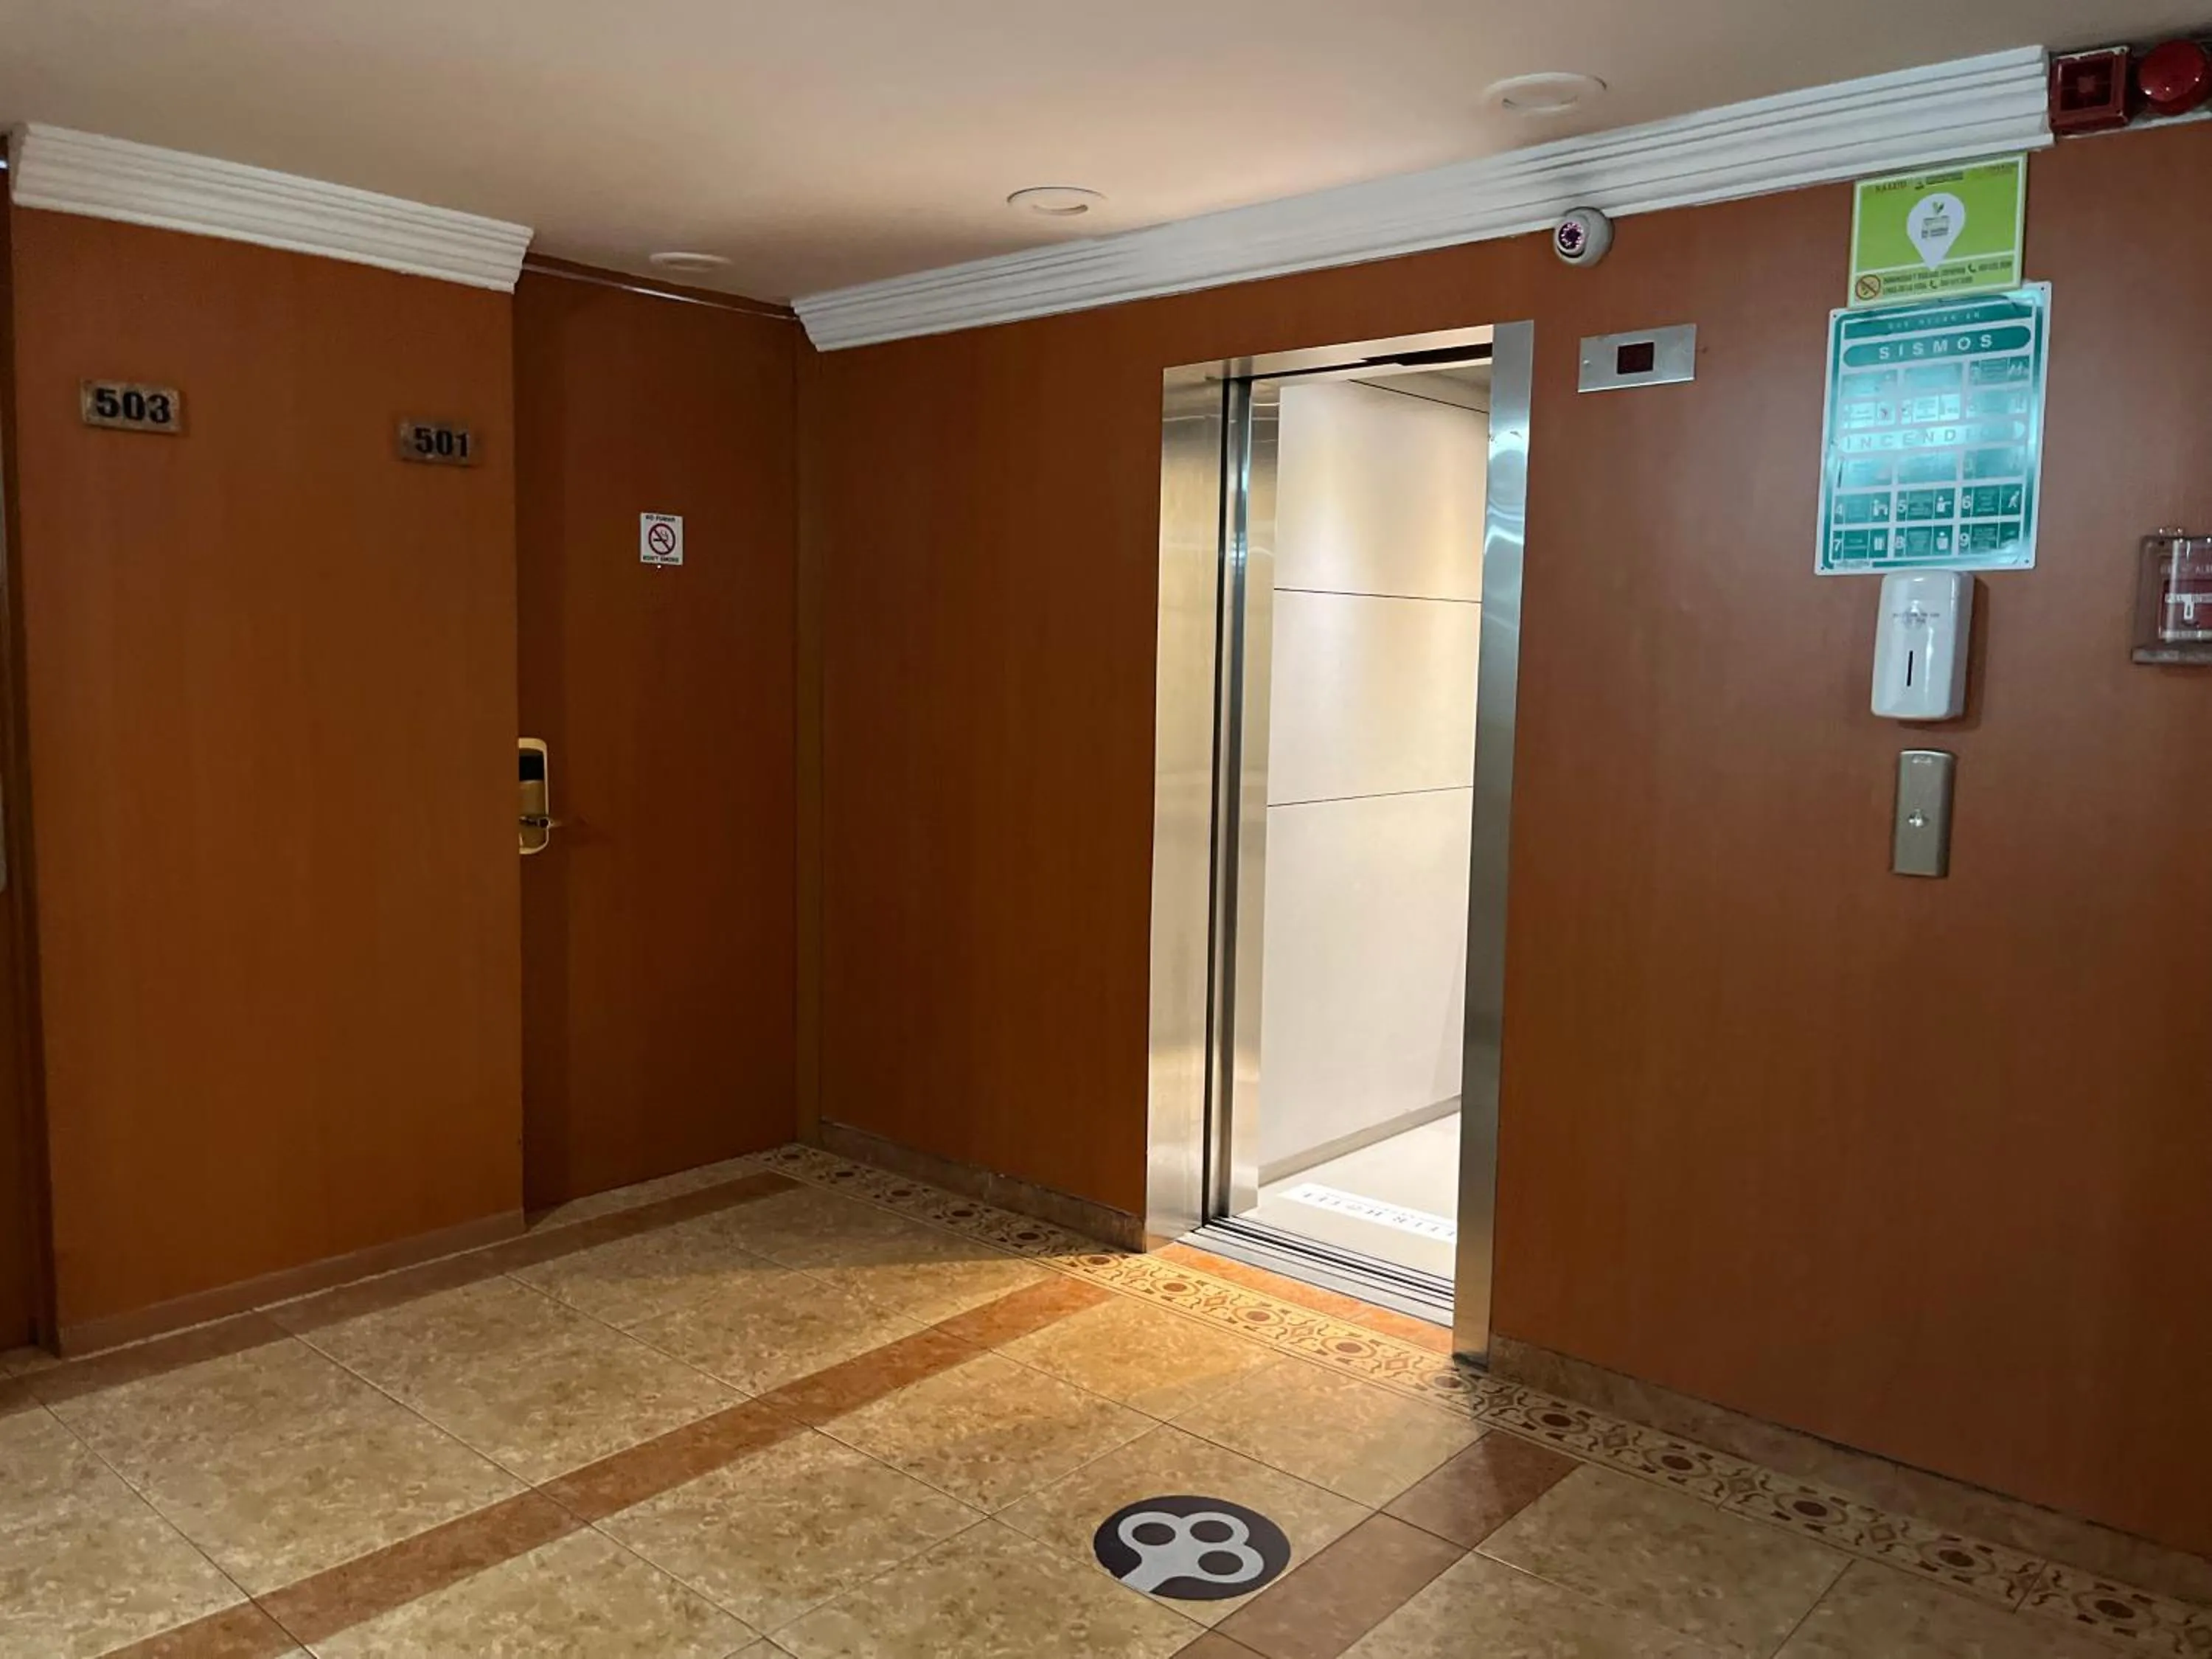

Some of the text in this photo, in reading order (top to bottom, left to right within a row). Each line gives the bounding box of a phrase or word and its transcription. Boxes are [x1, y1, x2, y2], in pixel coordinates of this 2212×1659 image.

[1879, 334, 1992, 359] SISMOS
[96, 387, 171, 423] 503
[414, 427, 467, 457] 501
[1962, 495, 1972, 509] 6
[1834, 538, 1843, 552] 7
[1960, 533, 1969, 547] 9
